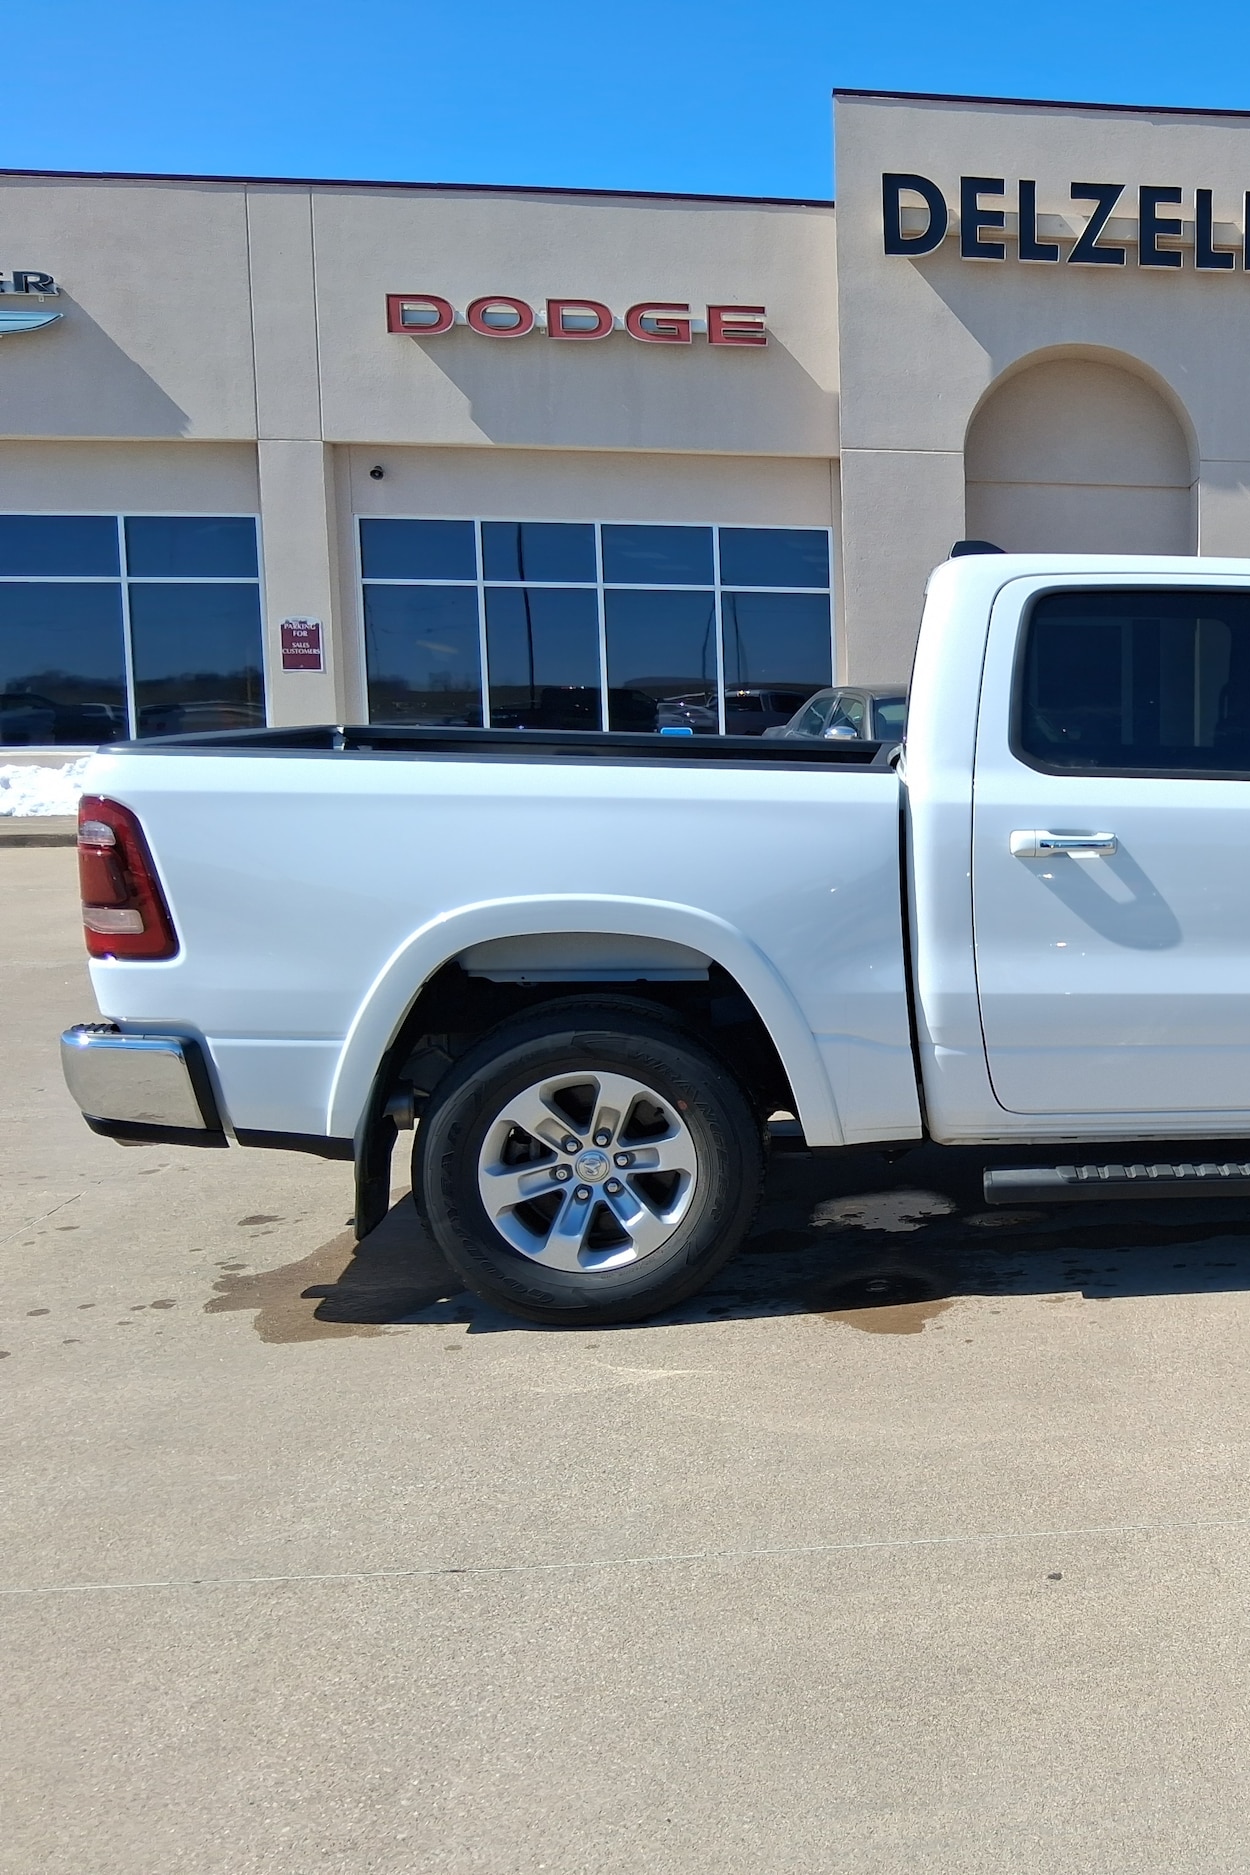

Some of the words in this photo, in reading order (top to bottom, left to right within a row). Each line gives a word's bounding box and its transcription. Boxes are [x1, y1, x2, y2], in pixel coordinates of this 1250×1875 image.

[385, 293, 768, 346] DODGE
[283, 622, 317, 630] PARKING
[633, 1049, 731, 1224] WRANGLER
[440, 1121, 556, 1304] GOODYEAR
